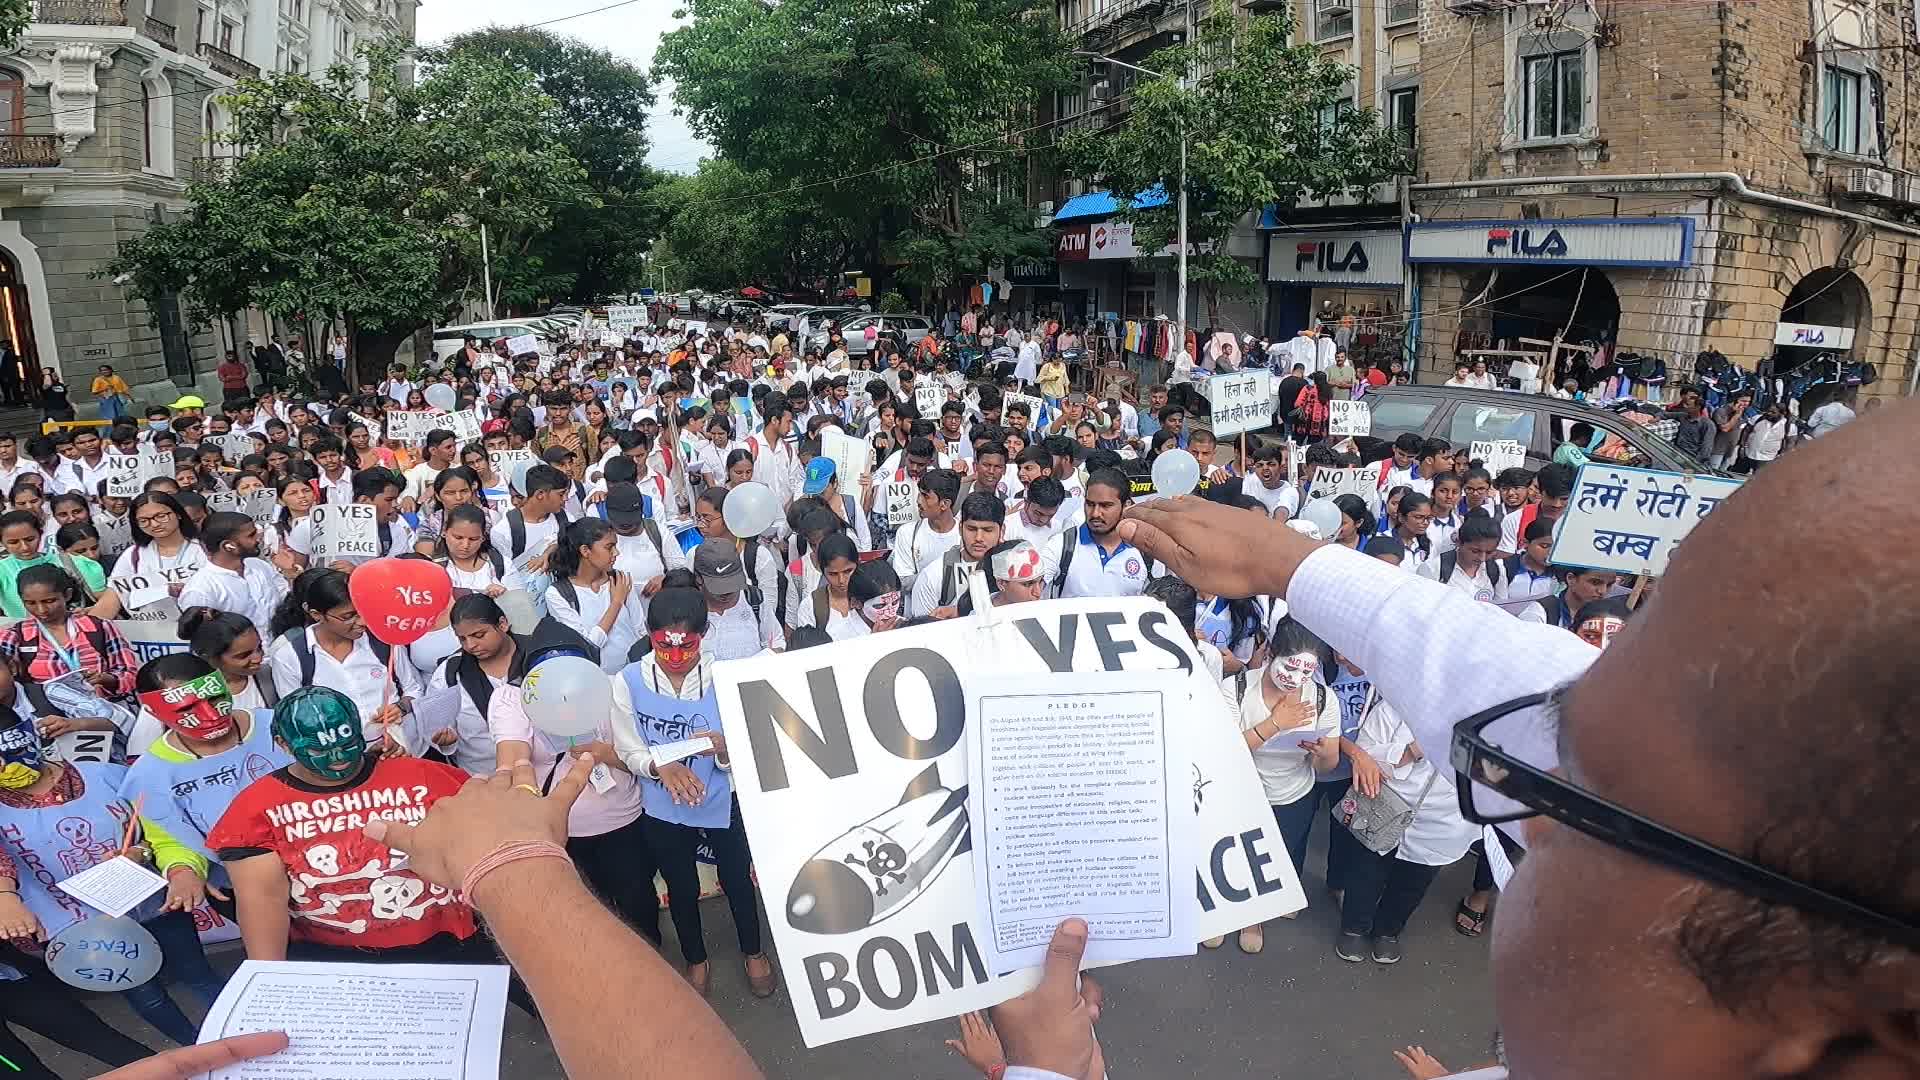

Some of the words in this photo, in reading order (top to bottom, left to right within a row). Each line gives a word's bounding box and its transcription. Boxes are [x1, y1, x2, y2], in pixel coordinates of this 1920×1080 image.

[1060, 233, 1086, 251] ATM
[1487, 229, 1567, 257] FILA
[1296, 241, 1369, 272] FILA
[1792, 328, 1824, 345] FILA
[917, 389, 935, 400] NO
[1332, 402, 1349, 412] NO
[1353, 402, 1370, 412] YES
[390, 412, 409, 421] NO
[414, 411, 437, 421] YES
[437, 416, 456, 427] NO
[203, 437, 227, 446] NO
[1472, 442, 1492, 455] NO
[1499, 443, 1524, 456] YES
[109, 457, 139, 469] NO
[148, 451, 173, 465] YES
[506, 452, 531, 461] YES
[1316, 471, 1343, 483] NO
[1352, 470, 1379, 482] YES
[109, 485, 140, 496] BOMB
[888, 484, 911, 497] NO
[1577, 473, 1628, 515] हमें
[1636, 476, 1692, 518] रोटी
[337, 505, 374, 519] YES
[890, 513, 913, 522] BOMB
[338, 541, 375, 553] PEACE
[1593, 530, 1661, 561] बम्ब
[113, 576, 149, 594] NO
[158, 563, 200, 582] YES
[395, 585, 433, 607] YES
[1047, 702, 1096, 710] PLEDGE
[738, 647, 966, 793] NO
[317, 724, 353, 746] NO
[285, 813, 367, 843] NEVER
[77, 940, 139, 960] PEACE
[74, 968, 133, 983] YES
[803, 921, 990, 1020] BOM
